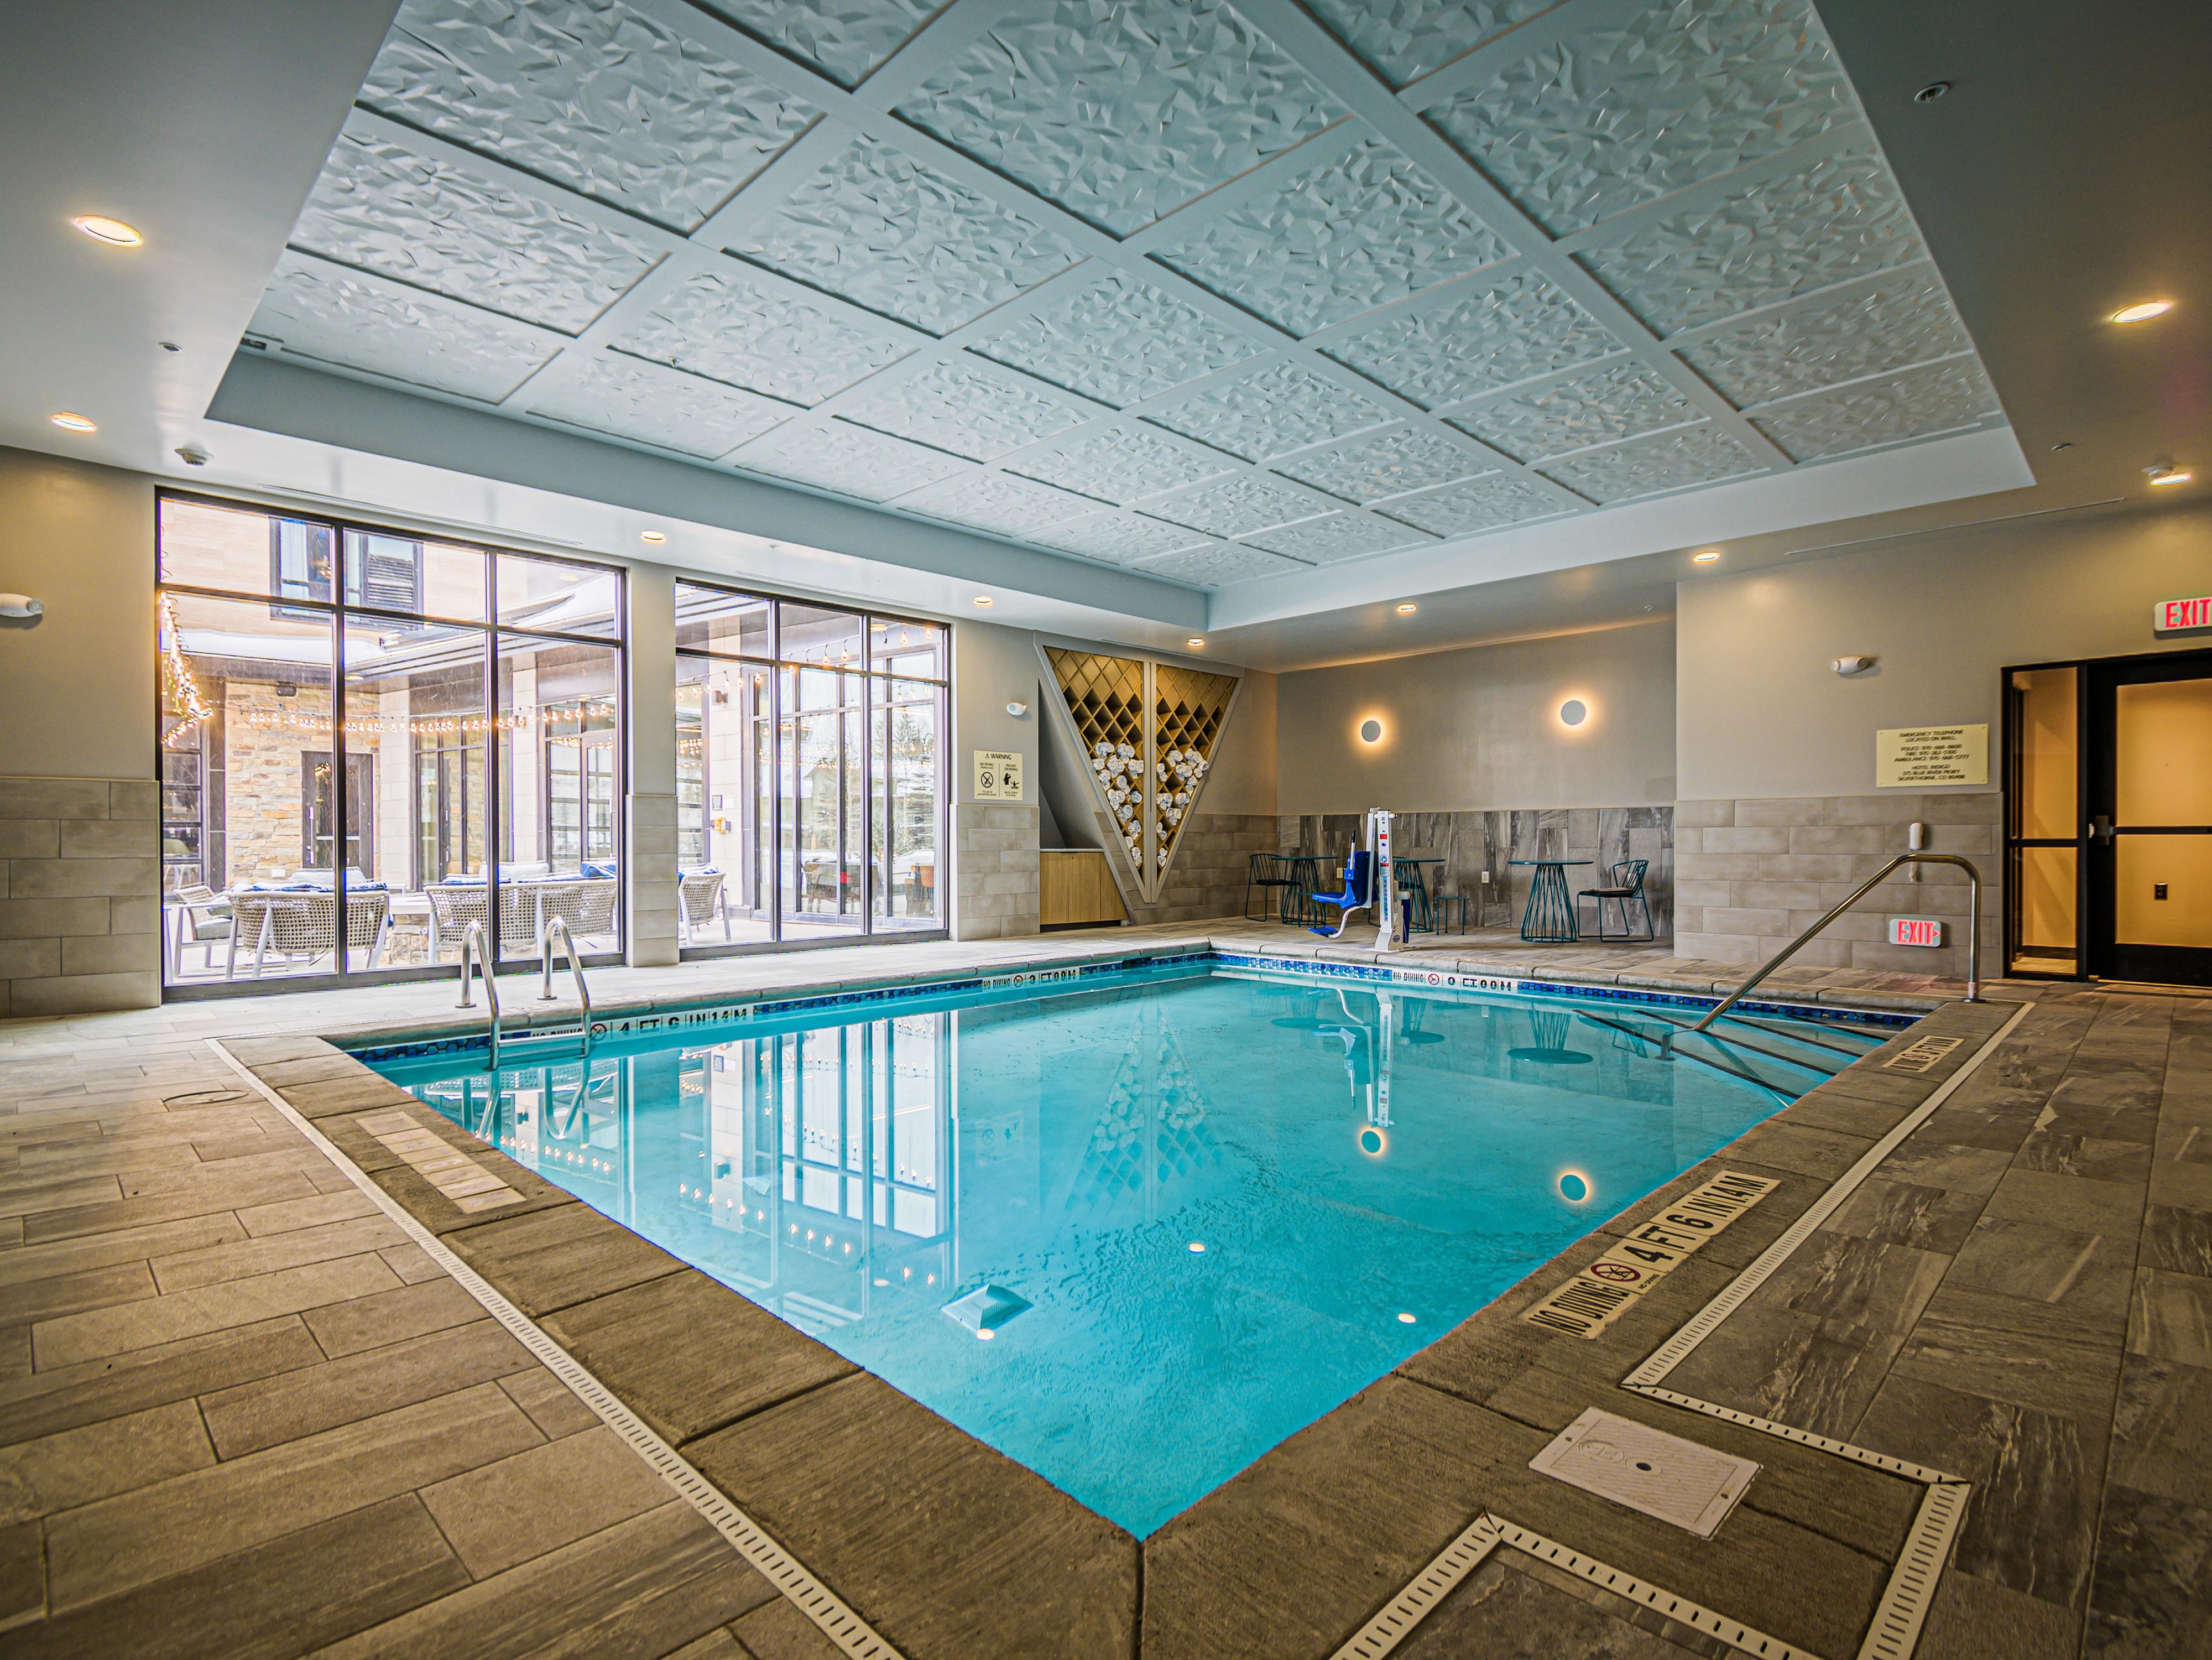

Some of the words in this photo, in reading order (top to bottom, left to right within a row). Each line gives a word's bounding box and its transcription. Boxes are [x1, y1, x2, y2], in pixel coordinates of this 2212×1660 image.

[2165, 599, 2211, 628] EXIT
[1897, 920, 1936, 945] EXIT
[1718, 1175, 1769, 1191] M
[1681, 1198, 1738, 1218] IN
[1666, 1214, 1714, 1229] 6
[1637, 1226, 1697, 1250] FT
[1623, 1245, 1674, 1265] 4
[1549, 1281, 1630, 1320] DIVING
[1528, 1310, 1593, 1337] NO
